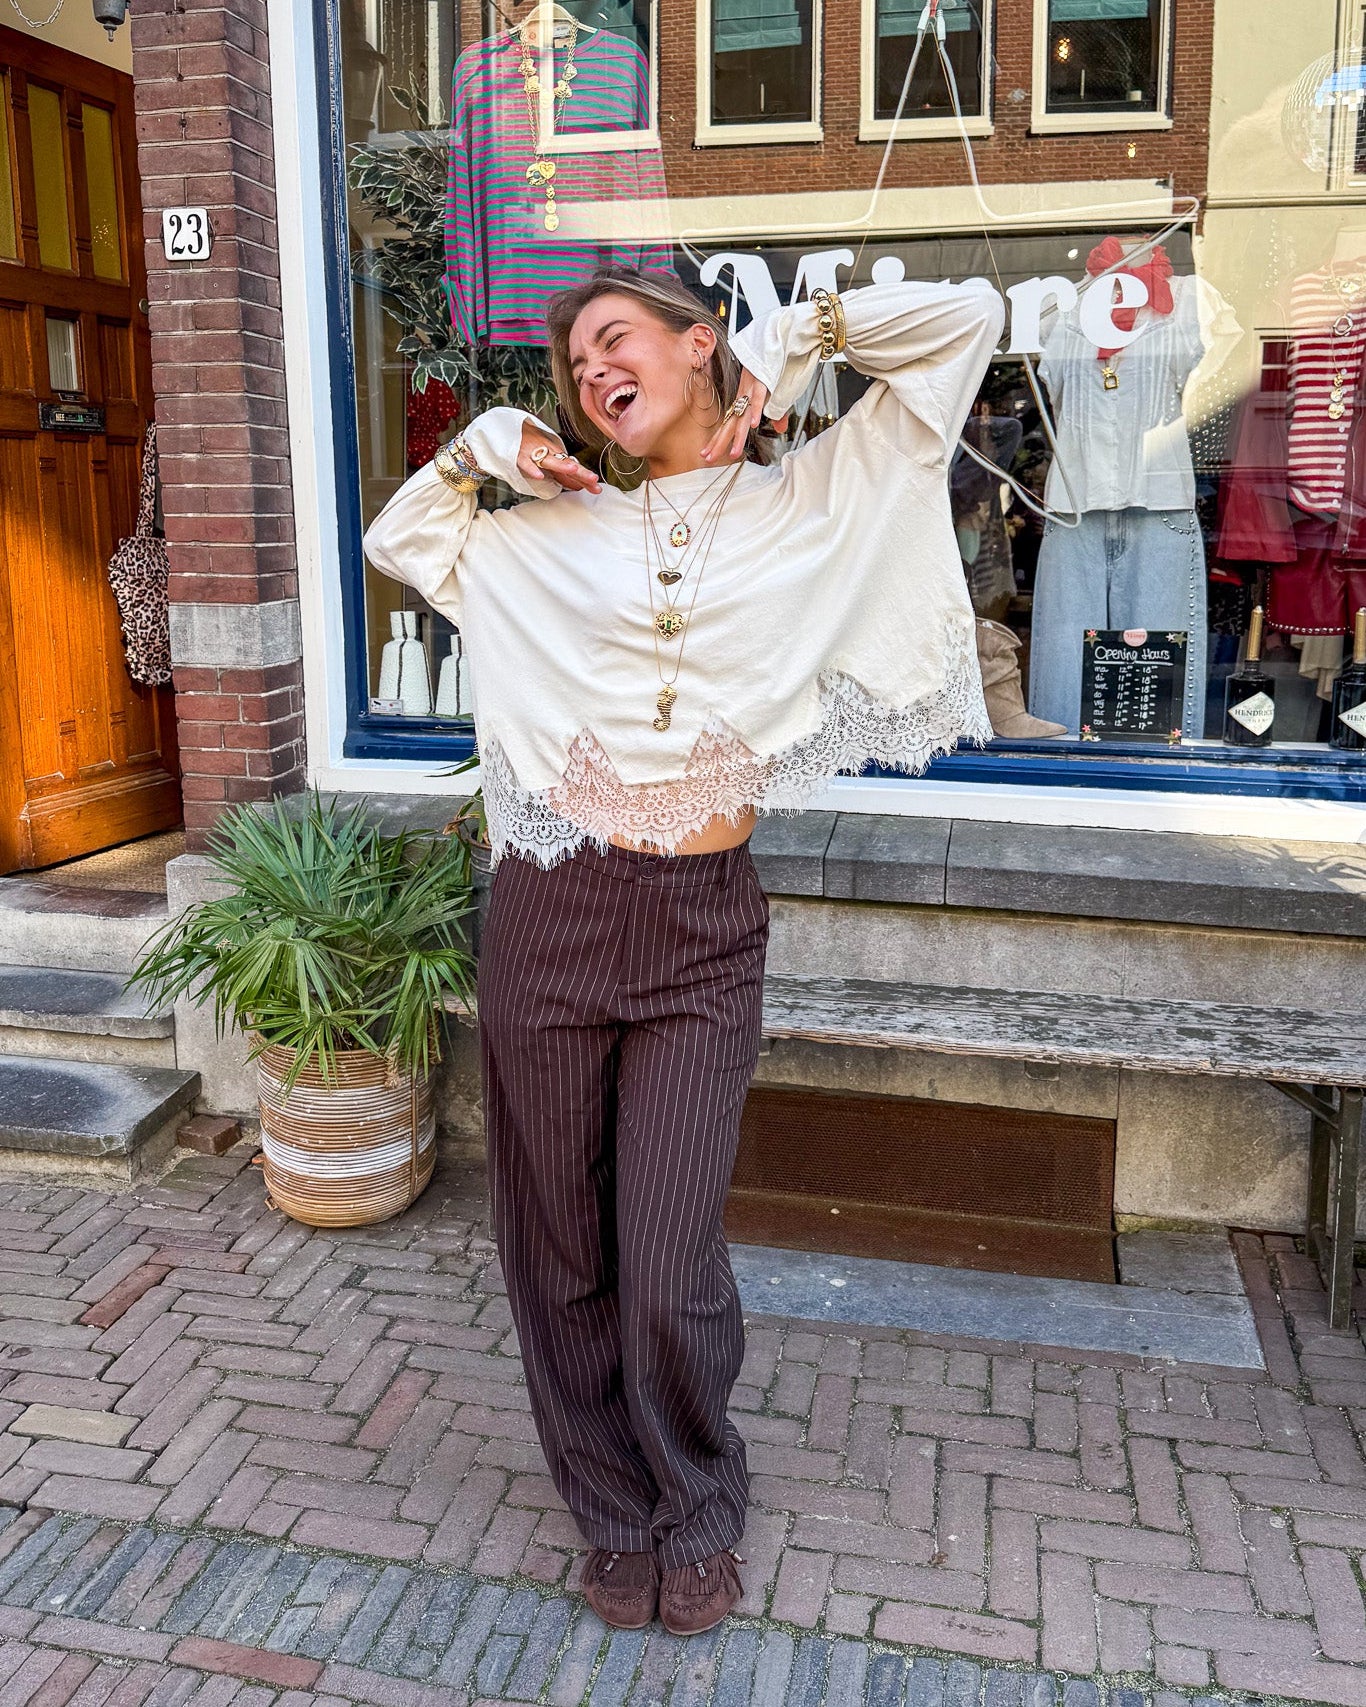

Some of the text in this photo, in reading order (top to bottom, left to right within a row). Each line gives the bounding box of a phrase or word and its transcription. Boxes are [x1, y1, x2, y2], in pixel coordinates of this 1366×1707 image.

[169, 213, 203, 256] 23
[1094, 645, 1138, 665] Opening
[1095, 672, 1105, 682] di
[1093, 690, 1102, 698] do
